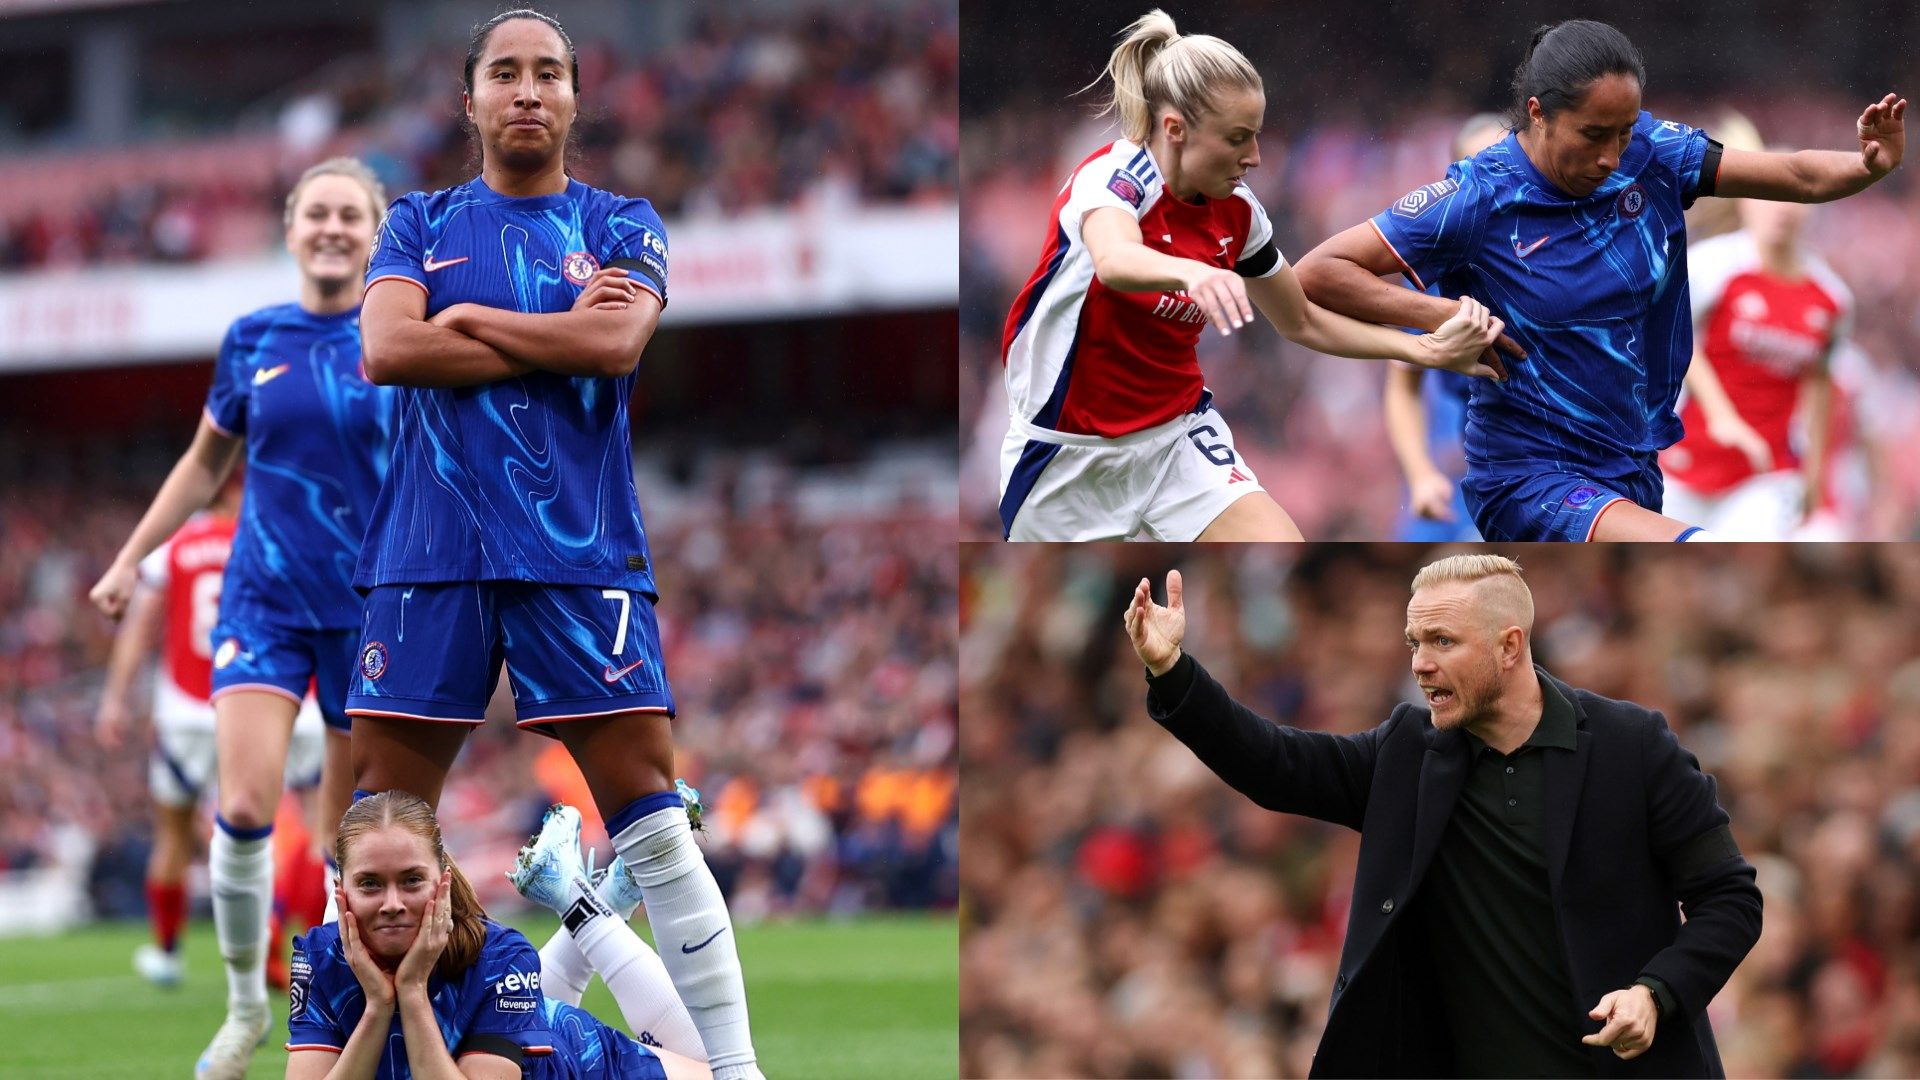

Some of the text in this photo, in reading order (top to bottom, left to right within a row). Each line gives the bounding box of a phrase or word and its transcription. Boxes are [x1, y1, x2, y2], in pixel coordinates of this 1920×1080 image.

[1152, 295, 1186, 320] FLY
[1187, 425, 1235, 466] 6
[602, 589, 630, 656] 7
